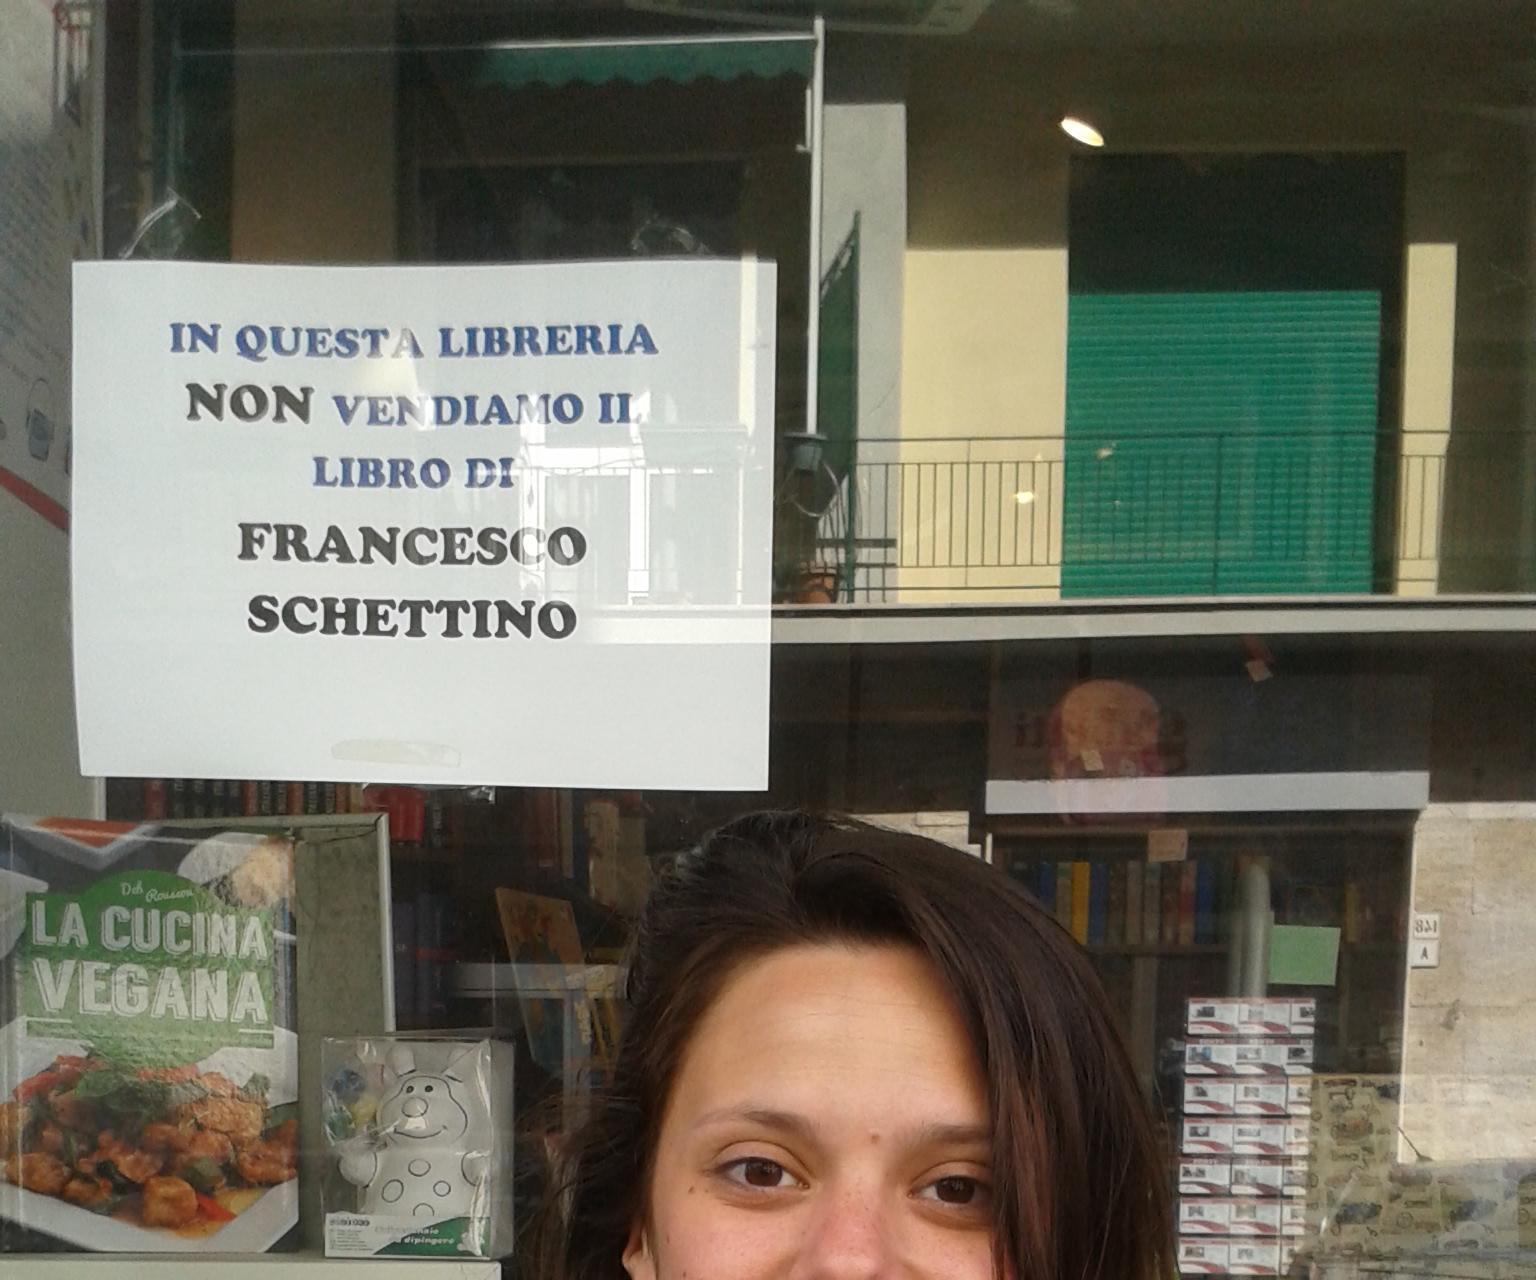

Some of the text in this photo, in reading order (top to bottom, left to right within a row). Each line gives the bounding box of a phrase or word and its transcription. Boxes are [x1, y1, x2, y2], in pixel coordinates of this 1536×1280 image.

[170, 323, 658, 362] IN QUESTA LIBRERIA
[186, 383, 637, 426] NON VENDIAMO IL
[313, 457, 515, 487] LIBRO DI
[237, 523, 587, 567] FRANCESCO
[247, 595, 577, 640] SCHETTINO
[32, 900, 268, 961] LA CUCINA
[32, 958, 269, 1024] VEGANA
